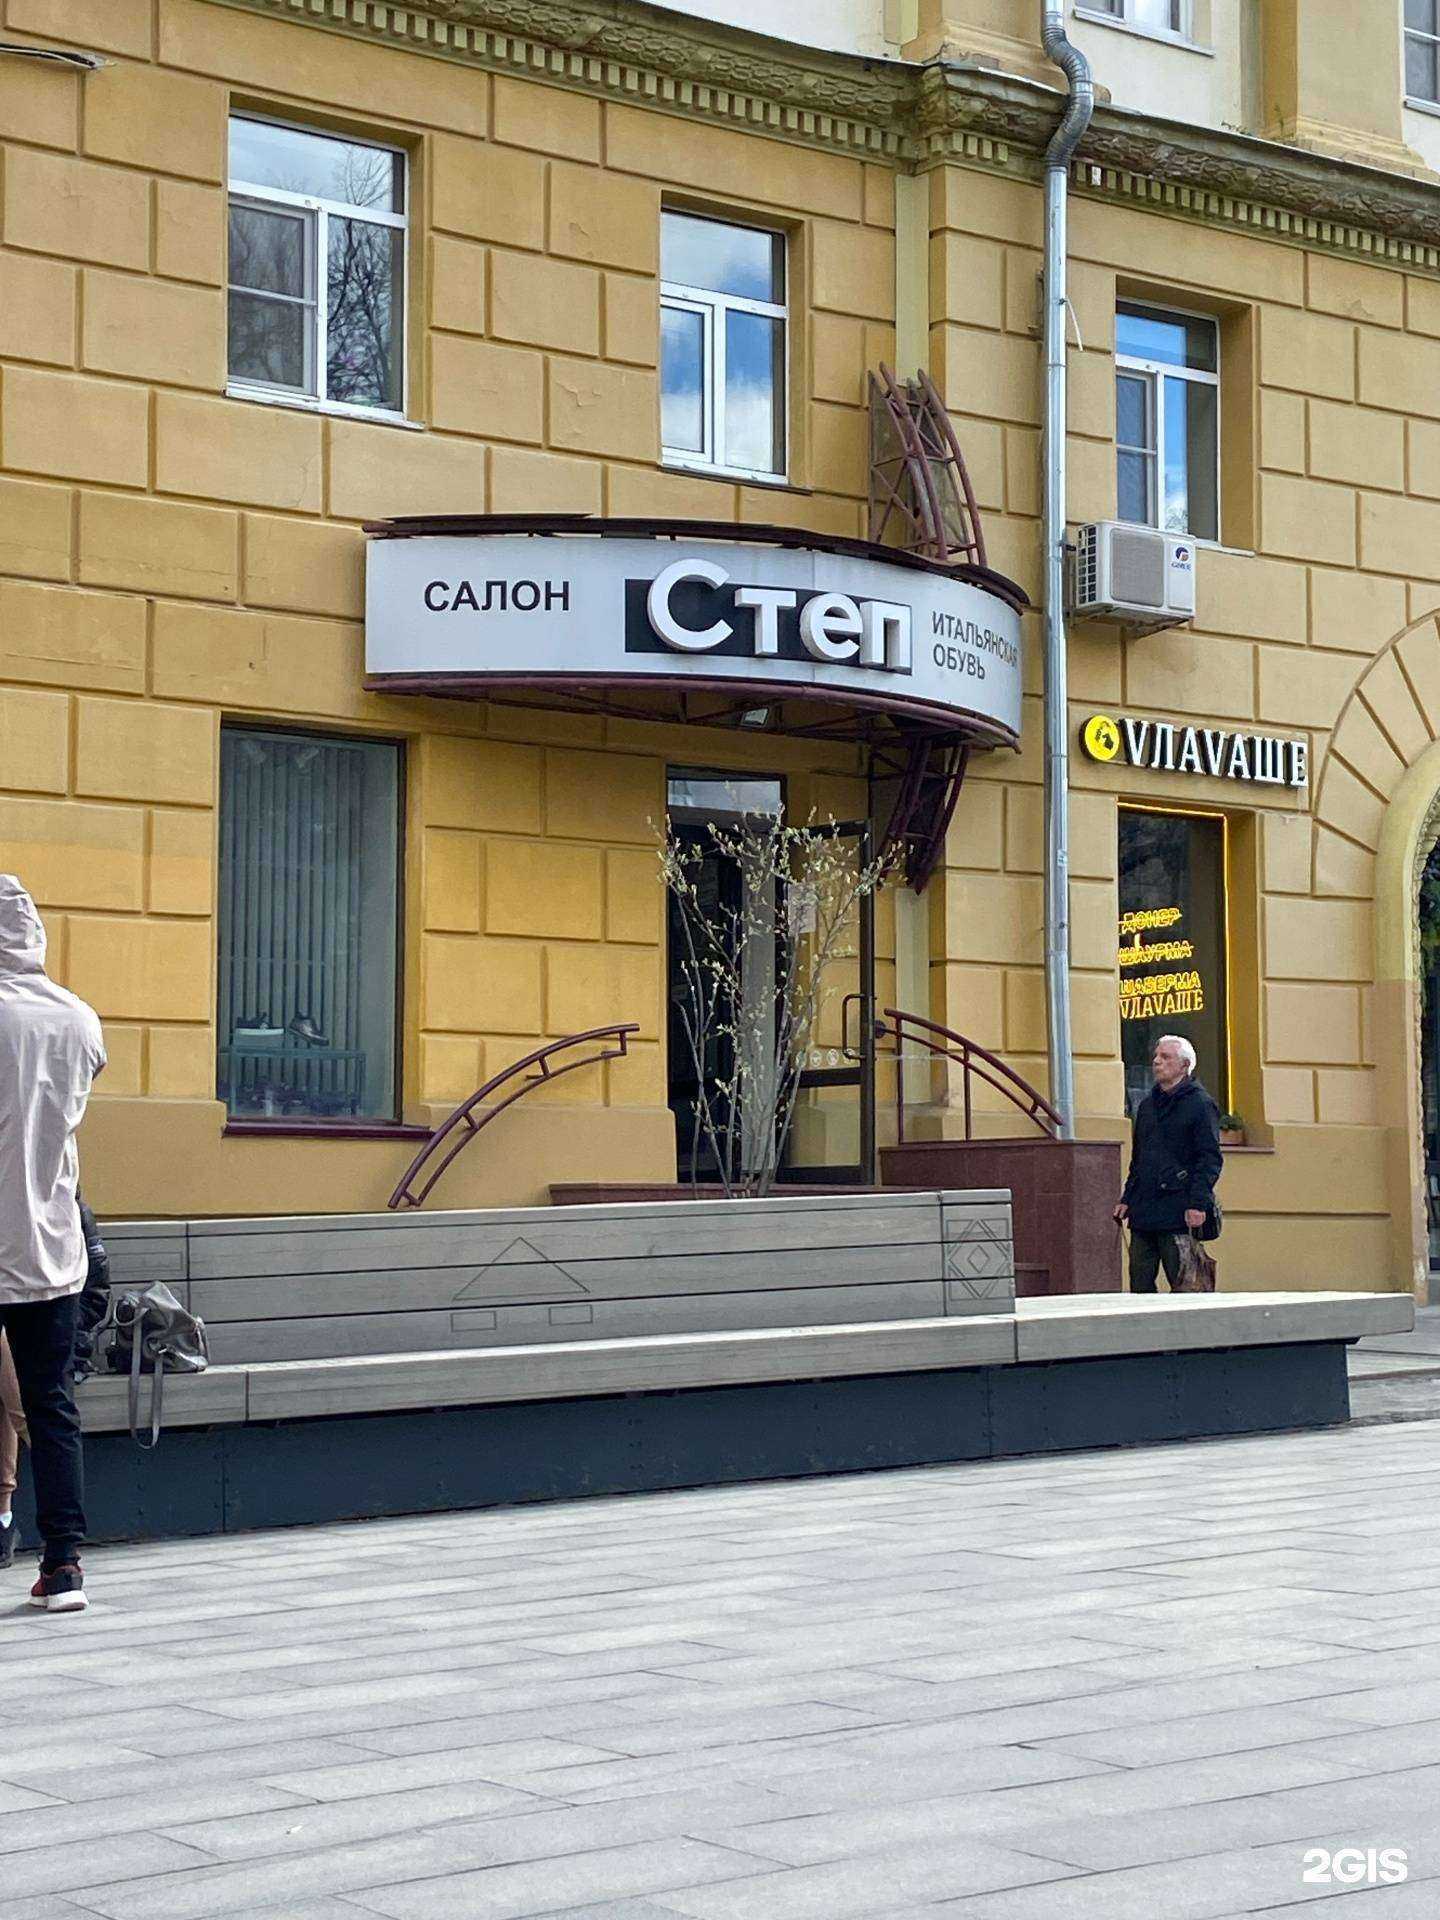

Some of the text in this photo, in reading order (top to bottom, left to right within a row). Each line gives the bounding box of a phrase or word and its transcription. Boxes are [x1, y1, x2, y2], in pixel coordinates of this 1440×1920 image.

[423, 558, 911, 673] САЛОН Степ
[933, 643, 986, 680] ОБУВЬ
